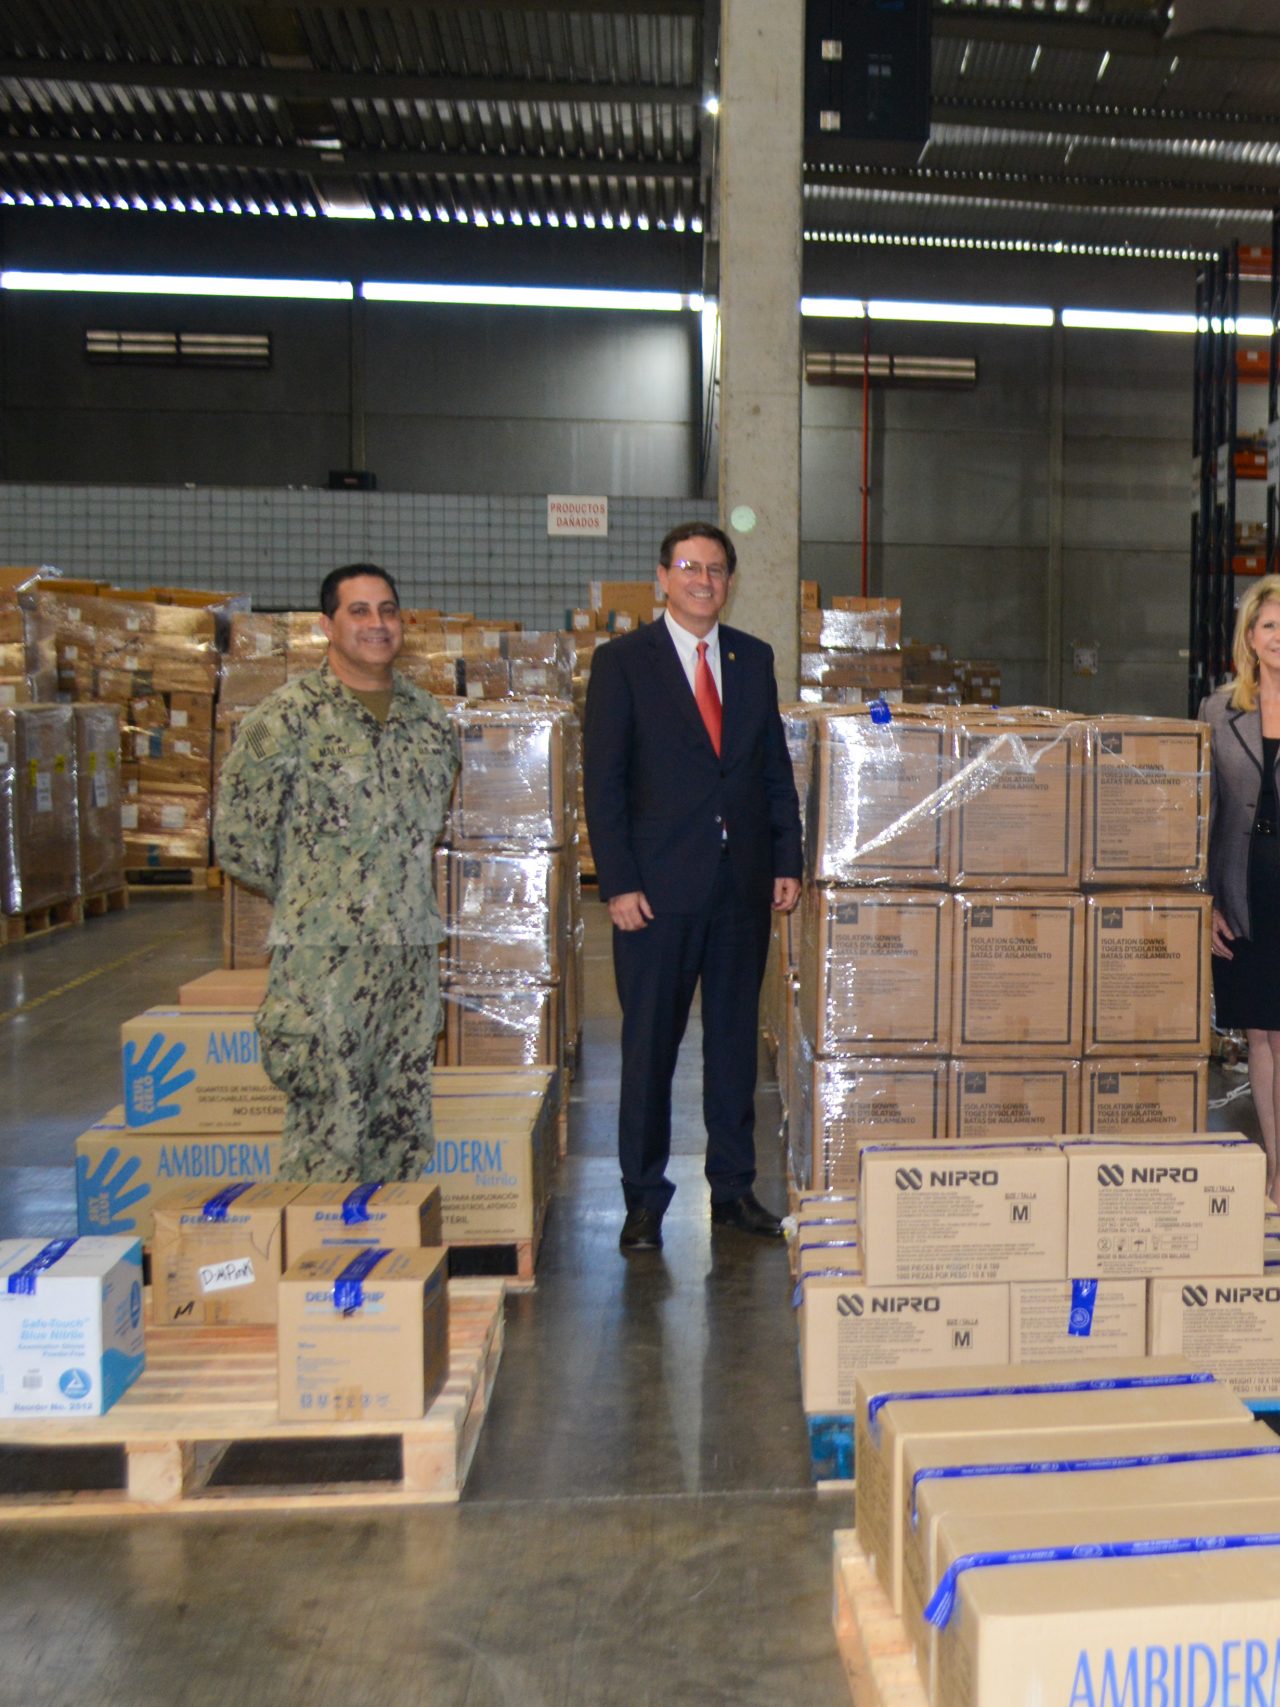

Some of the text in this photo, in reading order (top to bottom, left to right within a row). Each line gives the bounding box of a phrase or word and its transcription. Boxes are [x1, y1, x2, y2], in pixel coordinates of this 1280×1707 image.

[550, 503, 605, 514] PRODUCTOS
[556, 513, 600, 528] DAÑADOS
[206, 1030, 261, 1064] AMBI
[233, 1105, 285, 1116] NO ESTÉRI
[156, 1143, 271, 1177] AMBIDERM
[476, 1174, 518, 1186] Nitrilo
[930, 1170, 999, 1187] NIPRO
[1132, 1167, 1199, 1183] NIPRO
[1012, 1205, 1029, 1221] M
[1211, 1198, 1227, 1213] M
[1215, 1287, 1280, 1303] NIPRO
[872, 1297, 940, 1313] NIPRO
[954, 1331, 971, 1346] M
